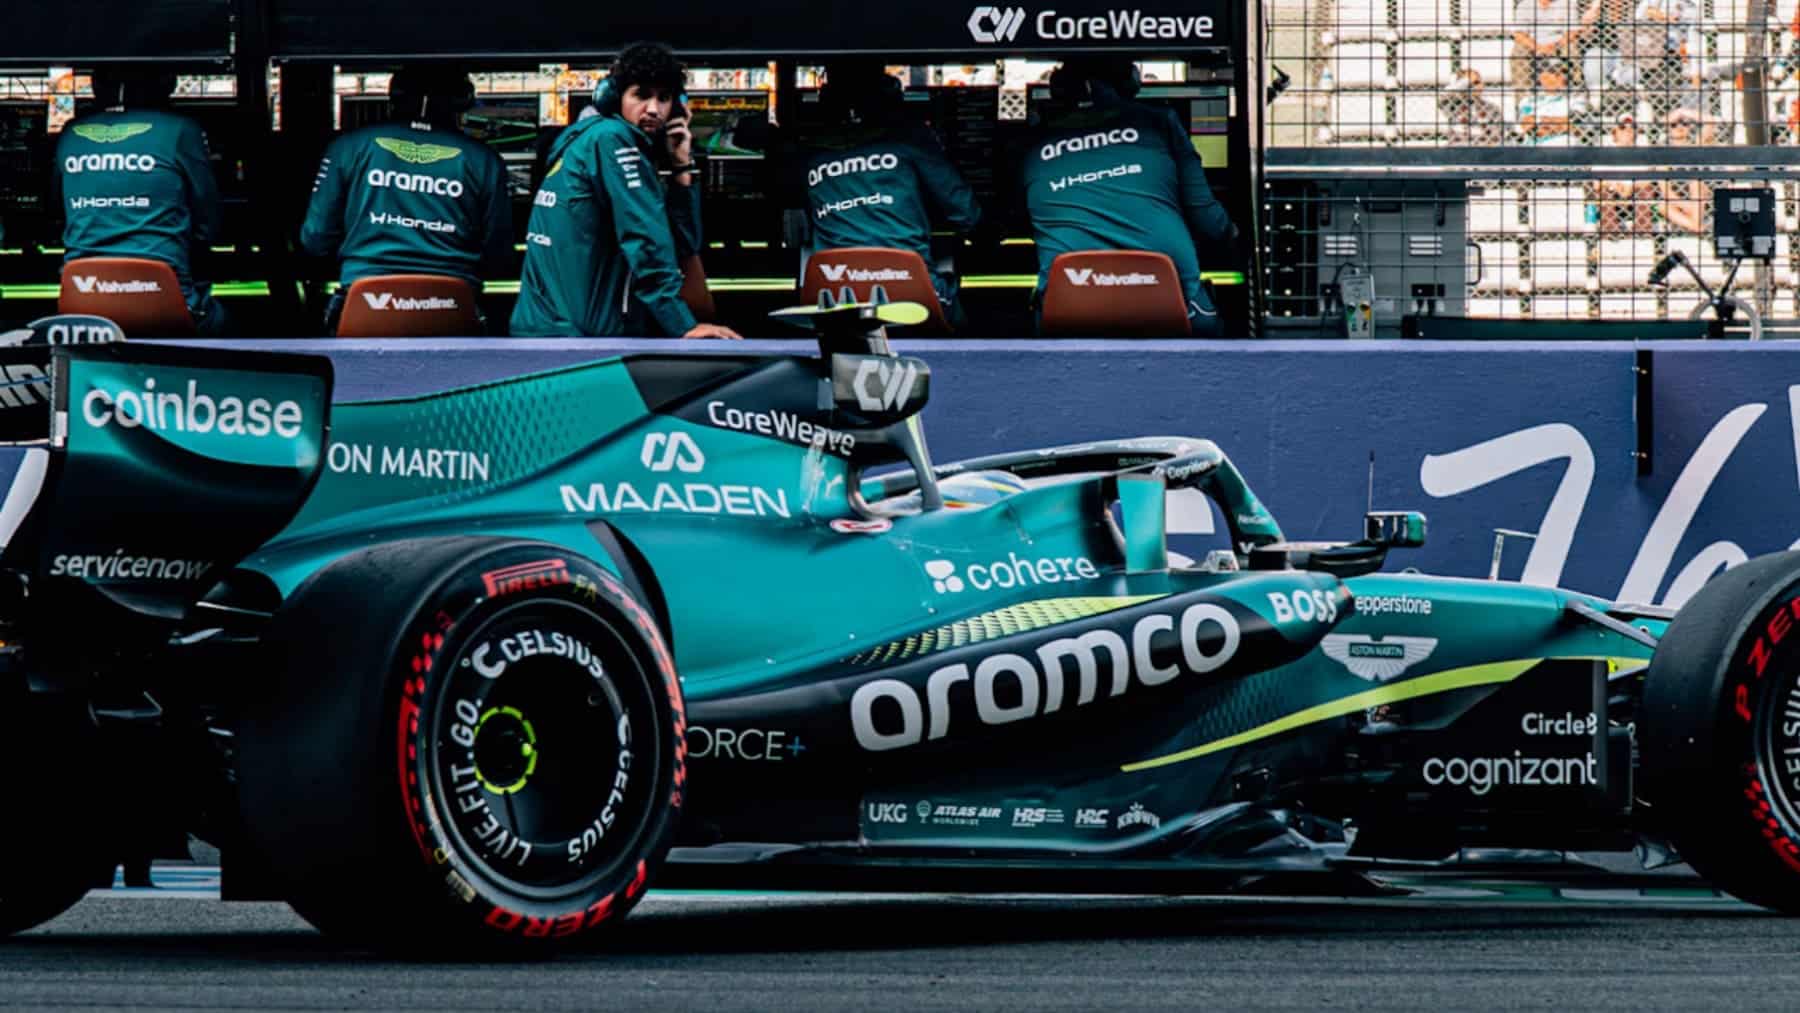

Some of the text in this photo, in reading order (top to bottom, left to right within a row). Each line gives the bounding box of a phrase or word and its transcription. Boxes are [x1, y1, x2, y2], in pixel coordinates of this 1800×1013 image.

[1036, 10, 1213, 40] CoreWeave
[1040, 127, 1139, 160] aramco
[65, 153, 156, 173] aramco
[808, 152, 898, 187] aramco
[1067, 163, 1143, 187] Honda
[368, 168, 464, 197] aramco
[826, 192, 894, 212] Honda
[386, 214, 457, 234] Honda
[82, 377, 303, 438] coinbase
[707, 400, 856, 456] CoreWeave
[380, 446, 490, 481] MARTIN
[559, 482, 792, 518] MAADEN
[50, 548, 212, 580] servicenow
[480, 558, 568, 599] PIRELLI
[966, 551, 1100, 591] cohere
[1267, 589, 1337, 624] BOSS
[1354, 593, 1433, 615] epperstone
[501, 630, 604, 679] CELSIUS
[850, 603, 1241, 752] aramco
[1521, 711, 1585, 735] Circle
[1422, 750, 1597, 795] cognizant
[868, 802, 908, 823] UKG
[932, 805, 1003, 819] ATLAS AIR
[1075, 807, 1110, 822] HRC
